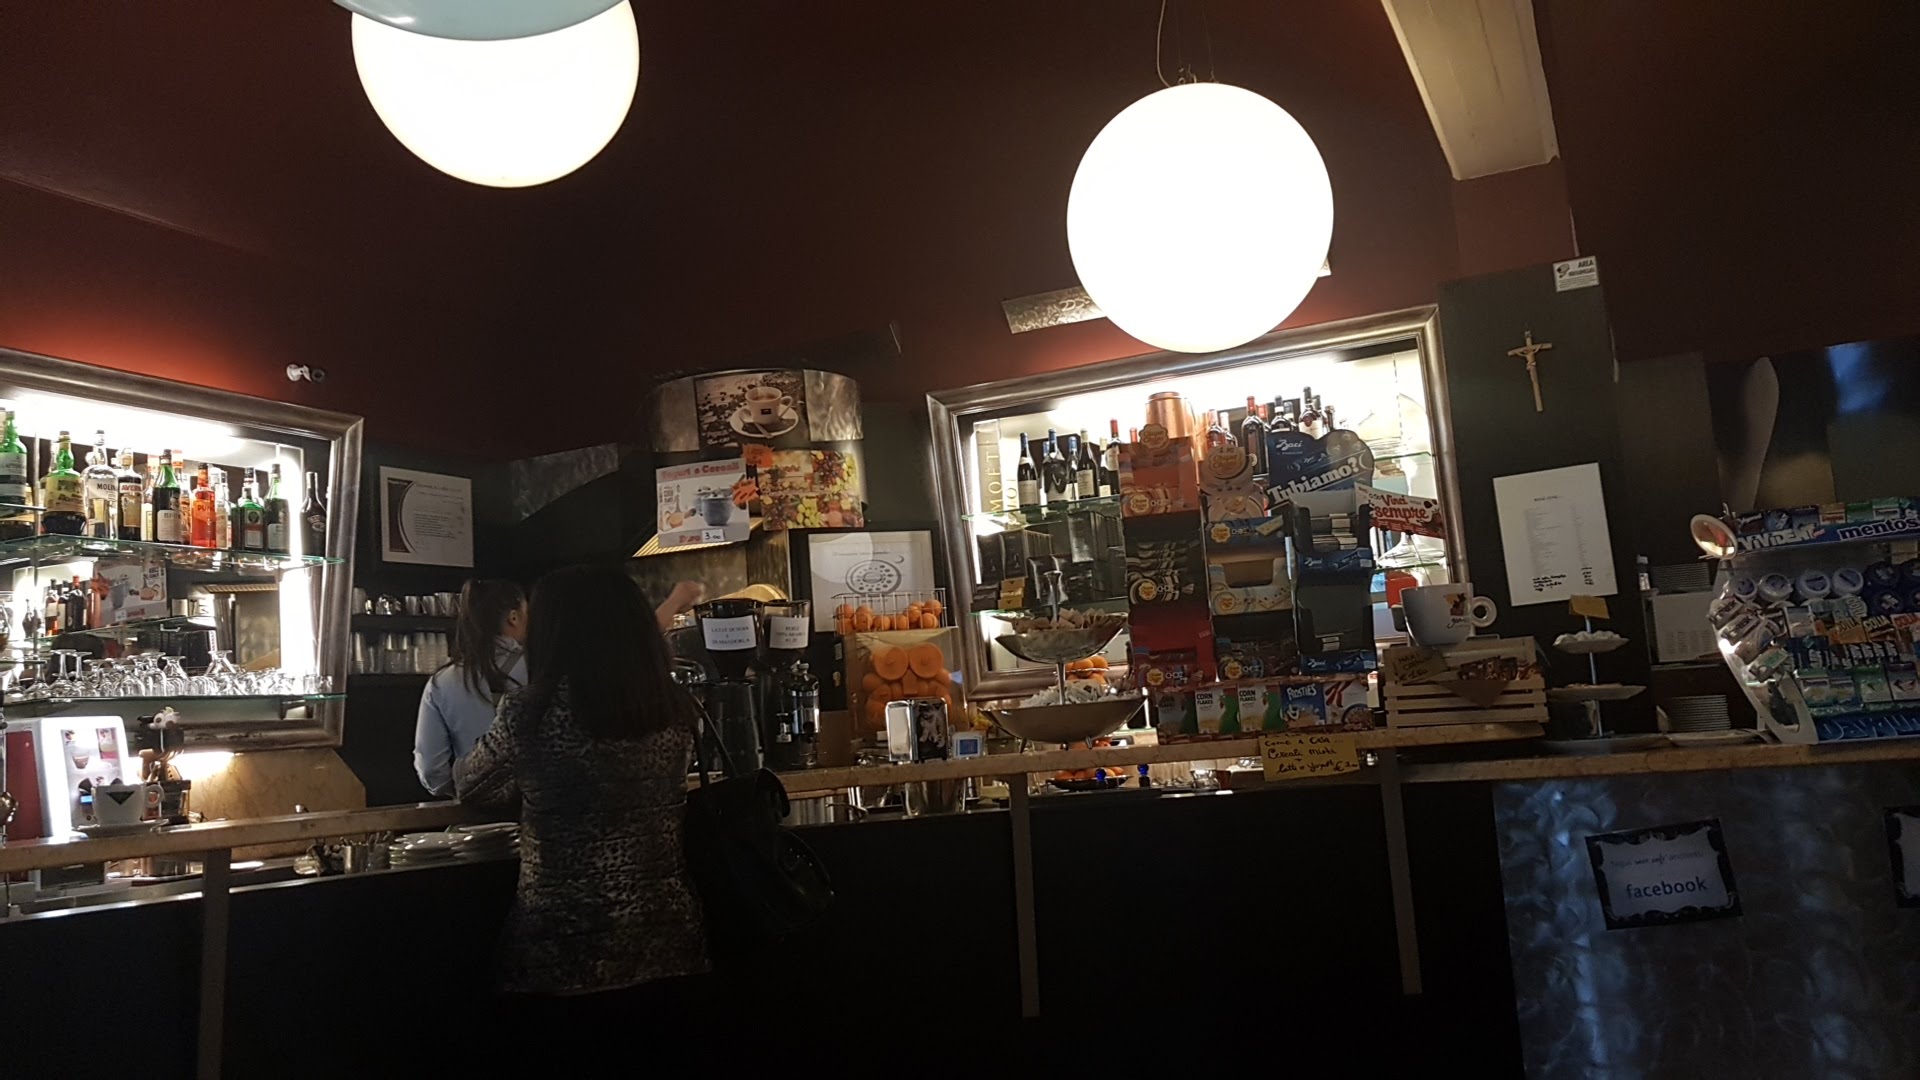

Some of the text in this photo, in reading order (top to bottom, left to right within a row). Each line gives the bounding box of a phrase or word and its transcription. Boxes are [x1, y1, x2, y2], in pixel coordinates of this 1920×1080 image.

[1380, 494, 1409, 506] Vinci
[1374, 505, 1430, 524] sempre
[1836, 515, 1920, 541] mentos
[1626, 876, 1708, 898] facebook
